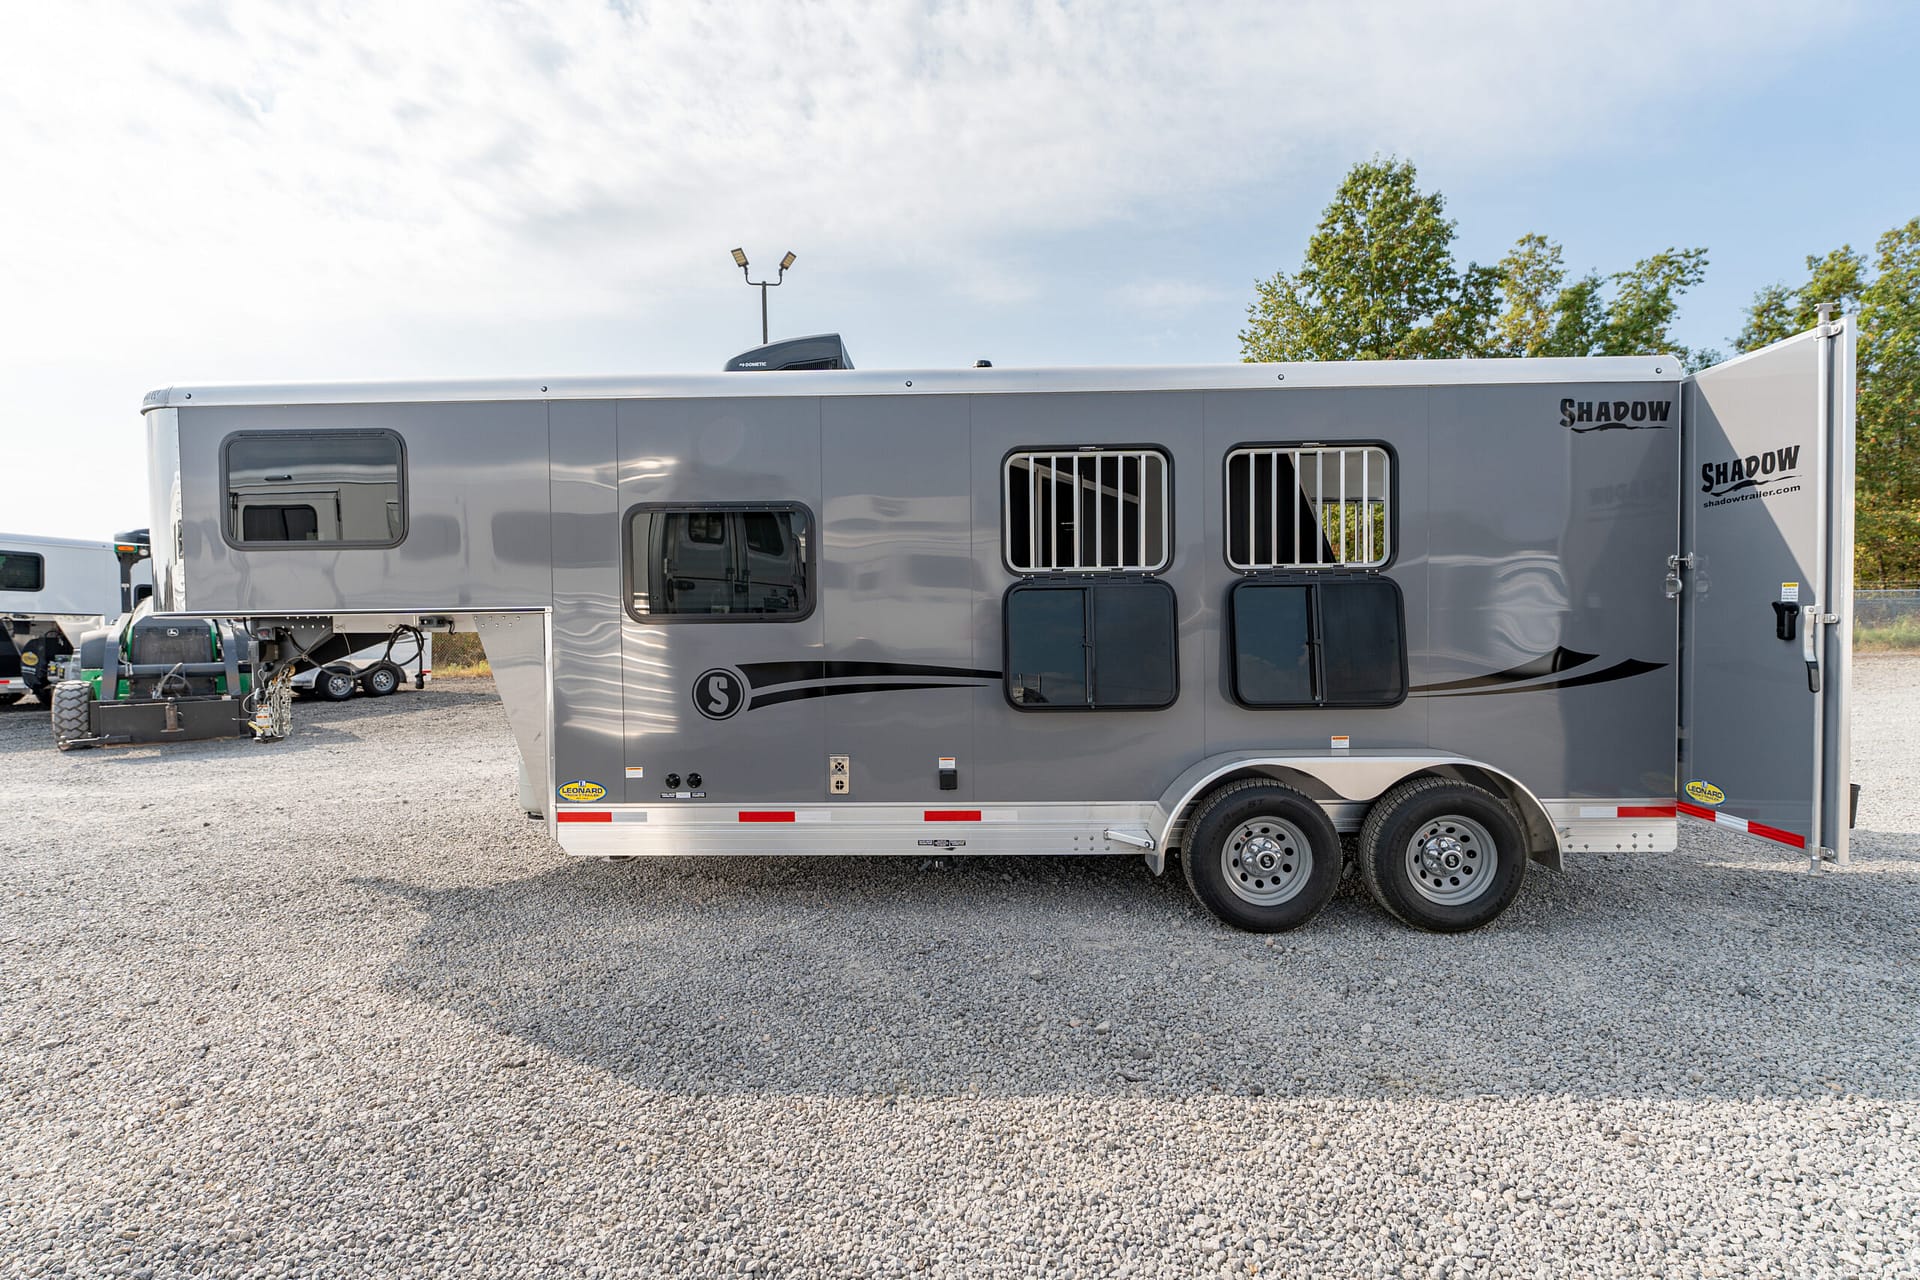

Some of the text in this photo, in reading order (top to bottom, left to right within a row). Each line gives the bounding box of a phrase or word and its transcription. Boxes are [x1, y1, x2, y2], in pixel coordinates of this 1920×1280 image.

[1559, 398, 1672, 427] SHADOW
[1701, 445, 1801, 493] SHADOW
[1703, 485, 1801, 509] shadowtrailer.com
[708, 676, 729, 713] S
[1687, 785, 1722, 798] LEONARD
